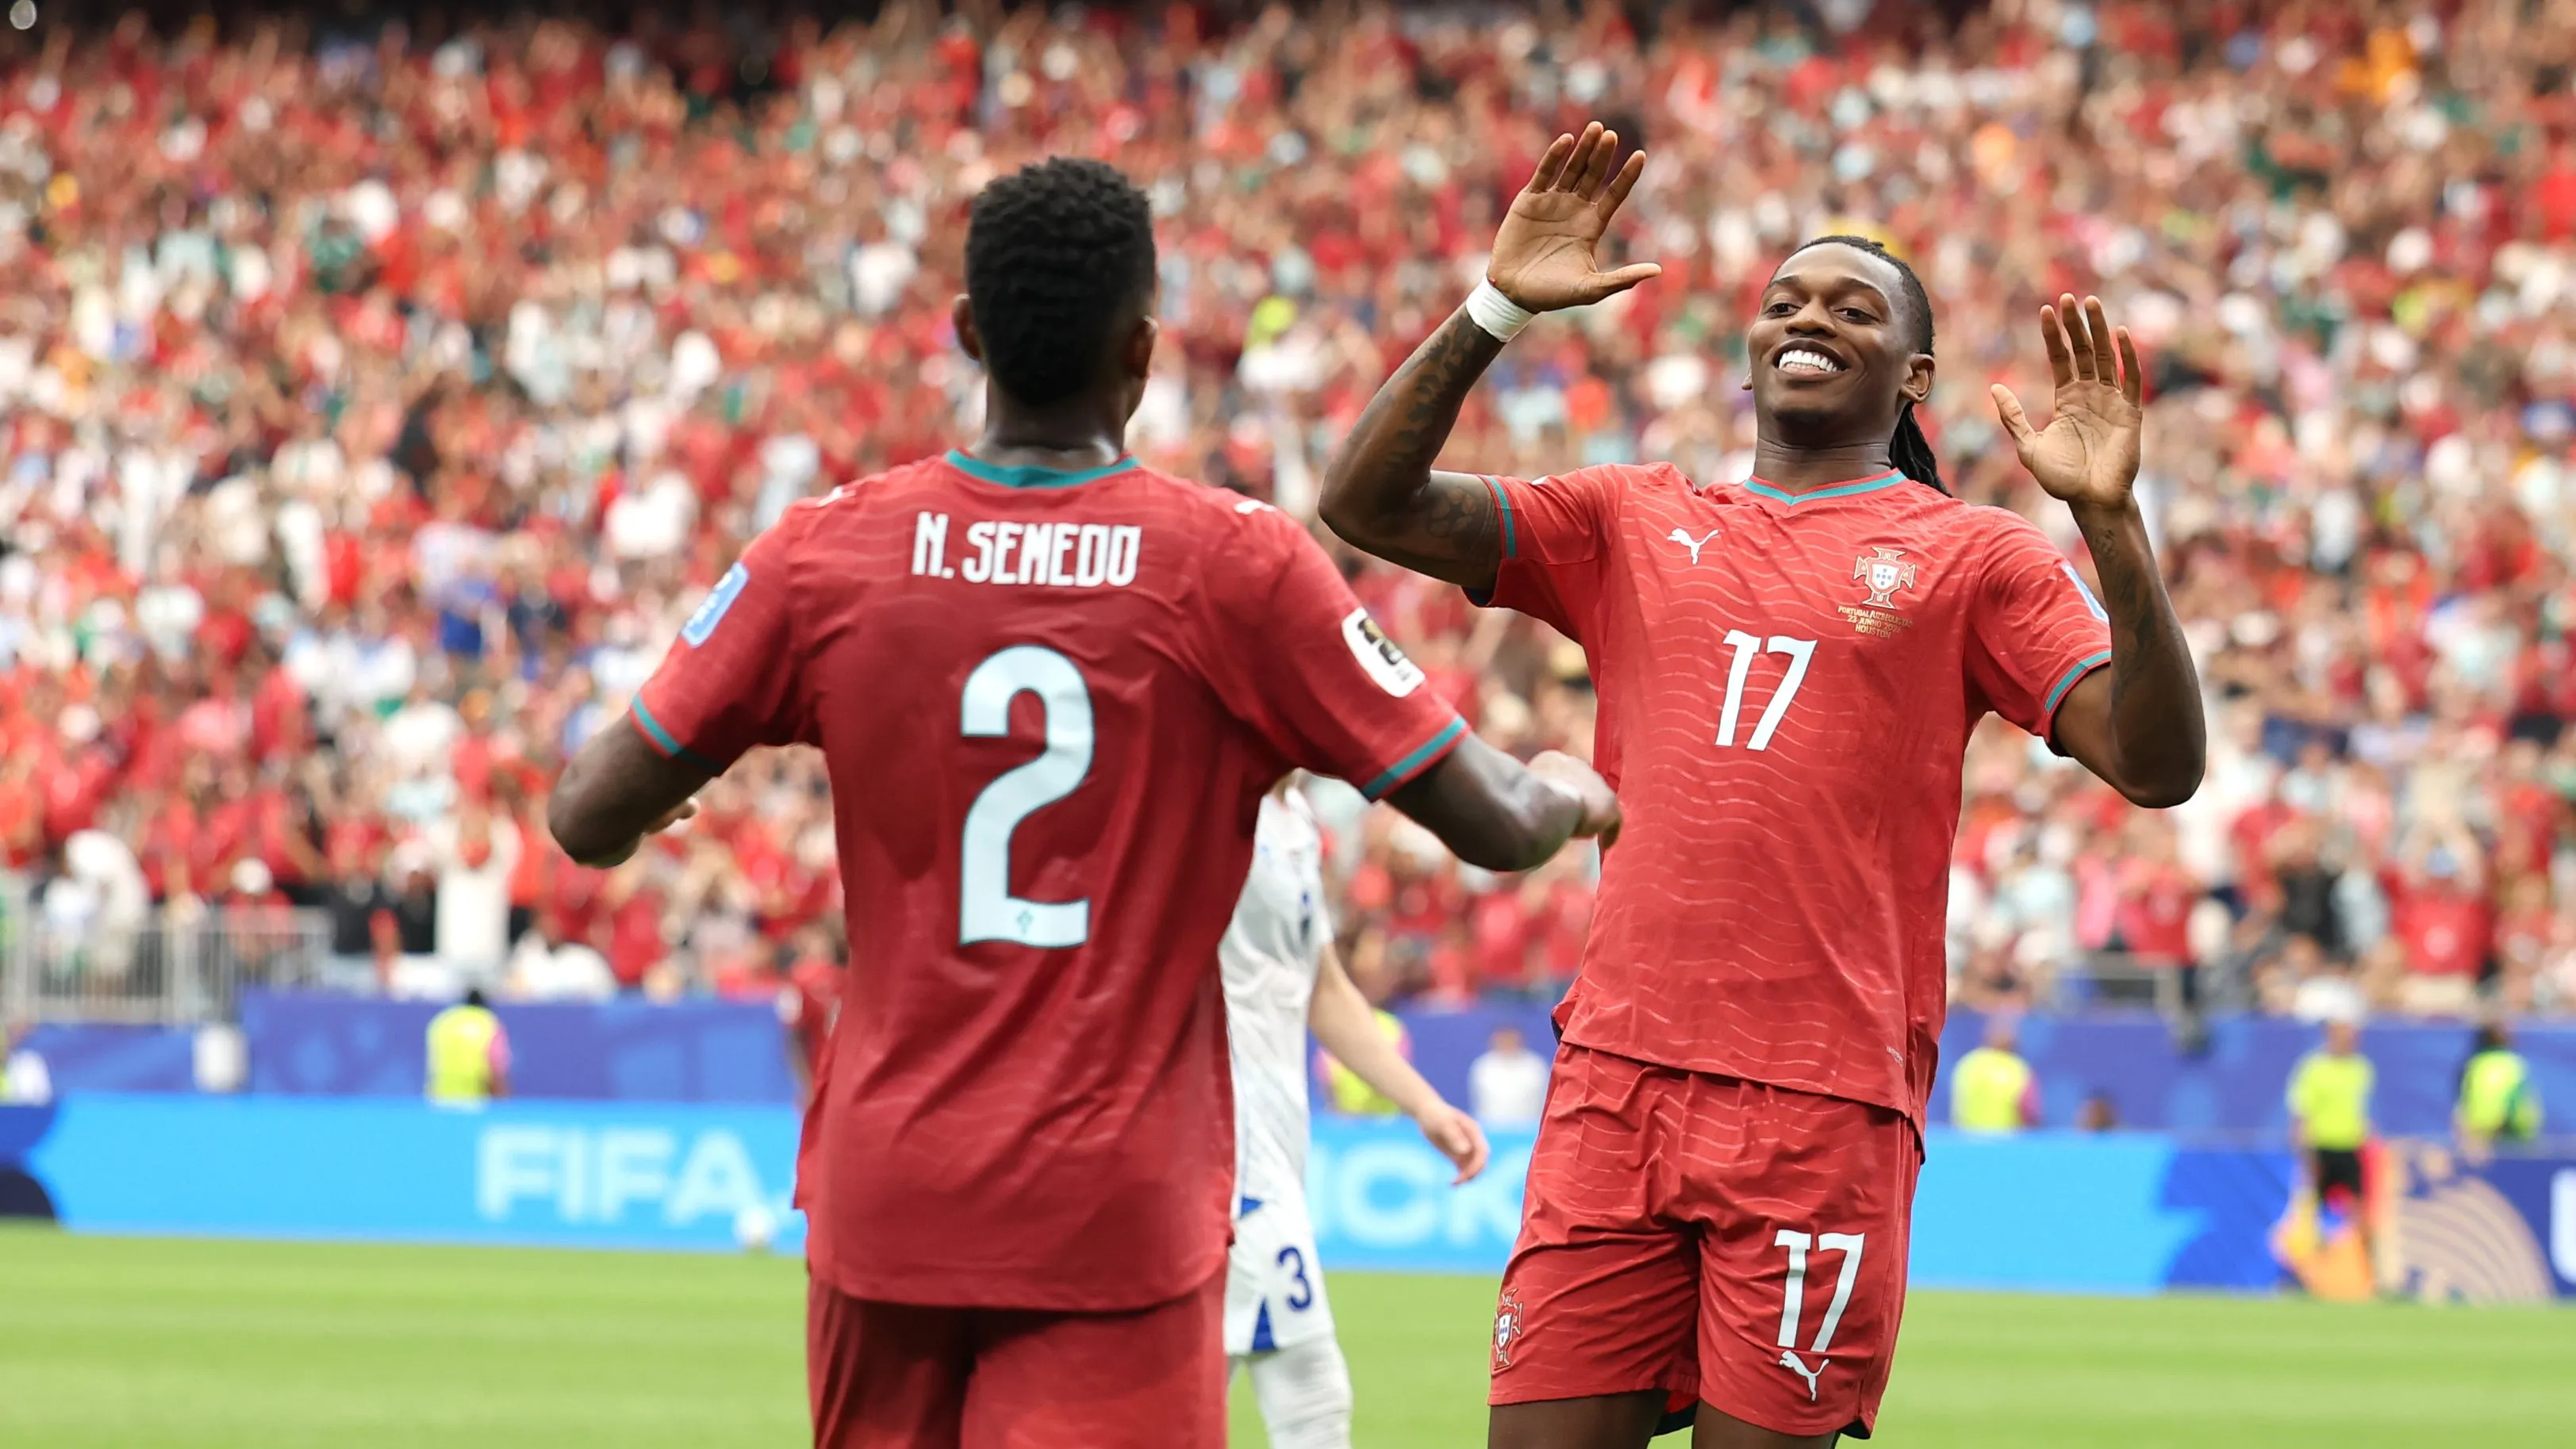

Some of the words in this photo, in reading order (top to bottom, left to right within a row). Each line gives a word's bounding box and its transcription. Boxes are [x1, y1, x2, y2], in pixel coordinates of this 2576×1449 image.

[912, 511, 954, 579] N.
[961, 521, 1142, 588] SEMEDO
[1855, 623, 1891, 639] HOUSTON
[1858, 617, 1881, 628] JUNHO
[1714, 629, 1818, 751] 17
[959, 643, 1095, 949] 2
[1276, 1246, 1313, 1313] 3
[1774, 1229, 1865, 1352] 17
